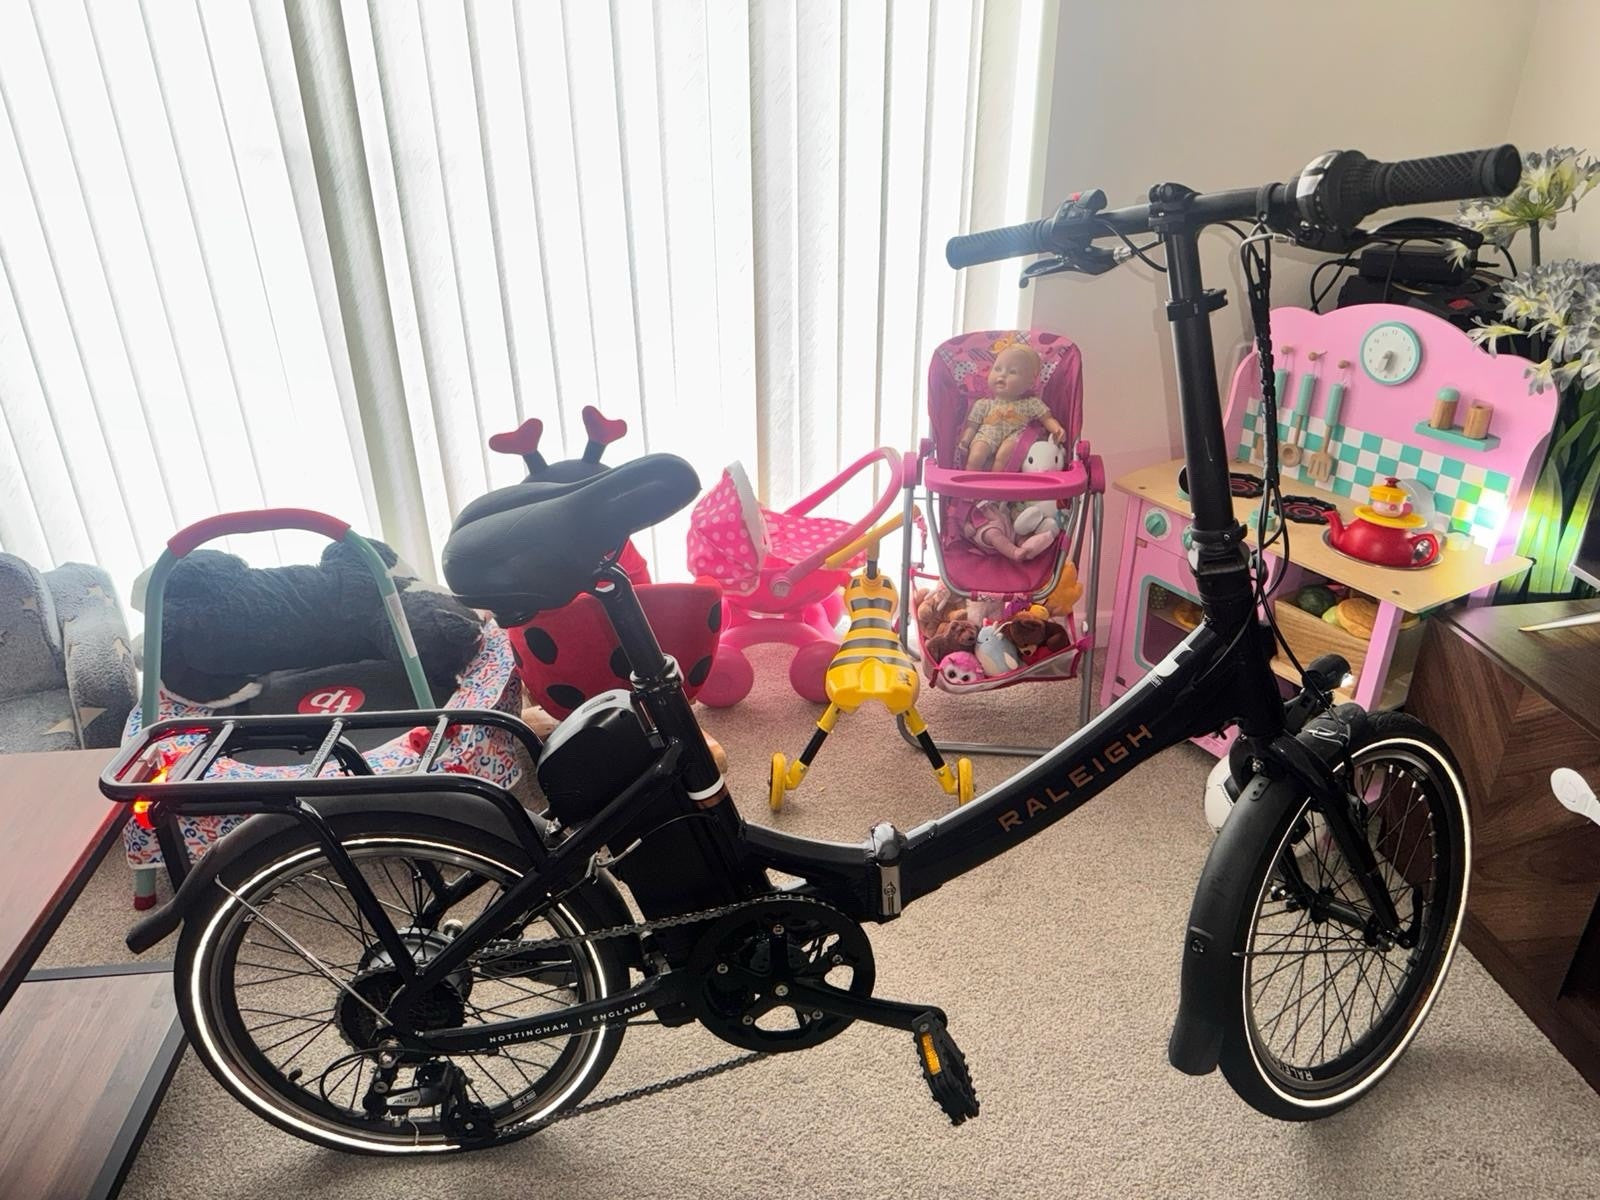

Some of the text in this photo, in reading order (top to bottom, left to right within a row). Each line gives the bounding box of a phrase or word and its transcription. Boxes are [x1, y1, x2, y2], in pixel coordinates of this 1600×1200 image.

[998, 725, 1153, 832] RALEIGH
[489, 1023, 569, 1043] NOTTINGHAM
[592, 1002, 647, 1021] ENGLAND
